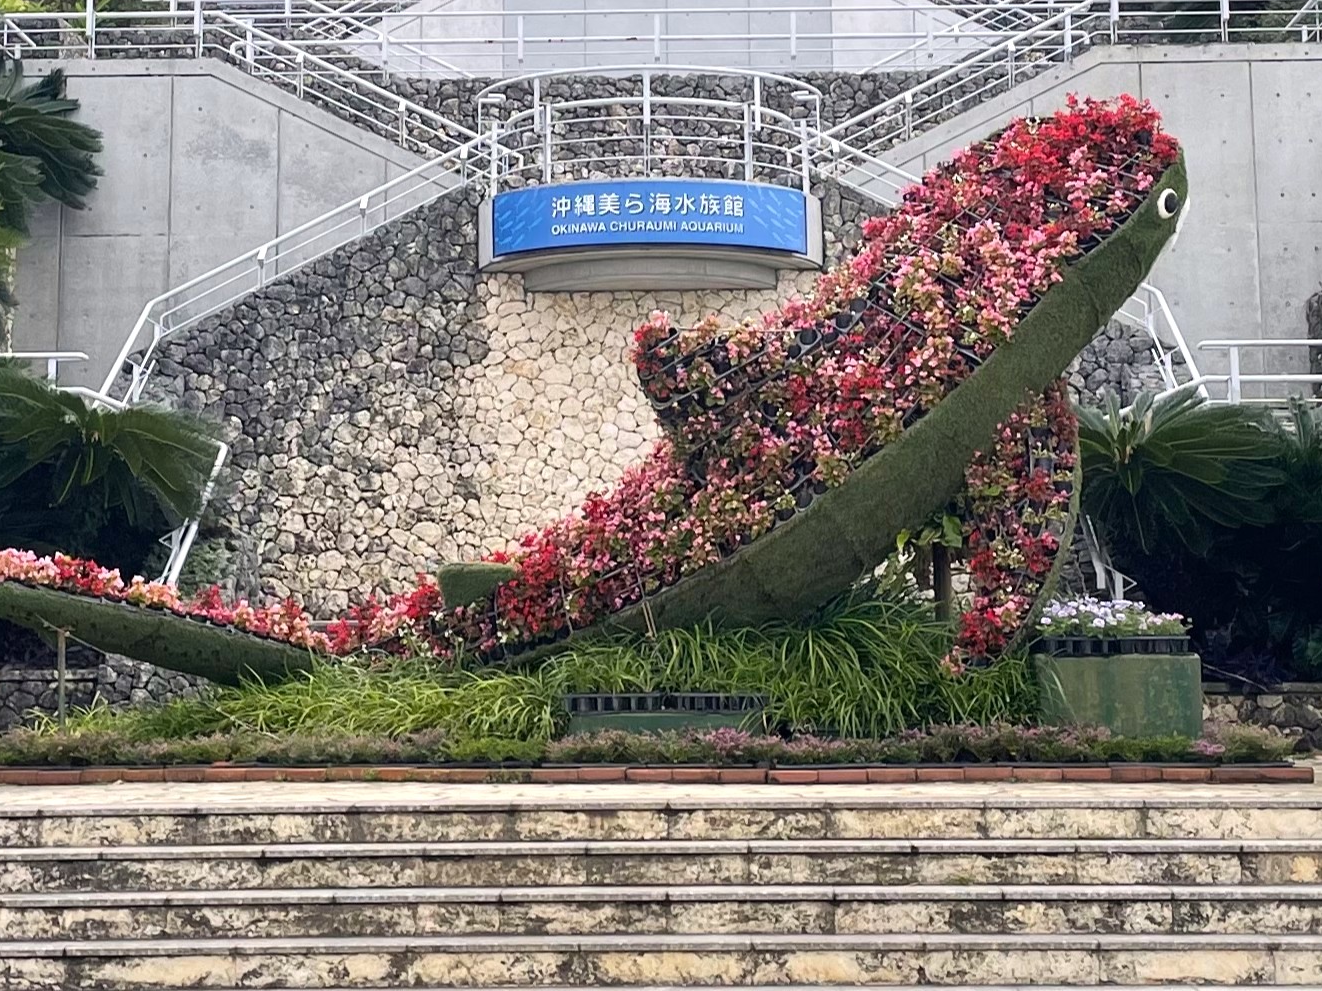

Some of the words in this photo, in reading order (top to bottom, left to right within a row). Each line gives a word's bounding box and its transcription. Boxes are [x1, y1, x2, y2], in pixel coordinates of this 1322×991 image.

[551, 192, 745, 218] 沖縄美ら海水族館
[551, 221, 607, 235] OKINAWA
[609, 220, 678, 233] CHURAUMI
[680, 220, 745, 234] AQUARIUM
